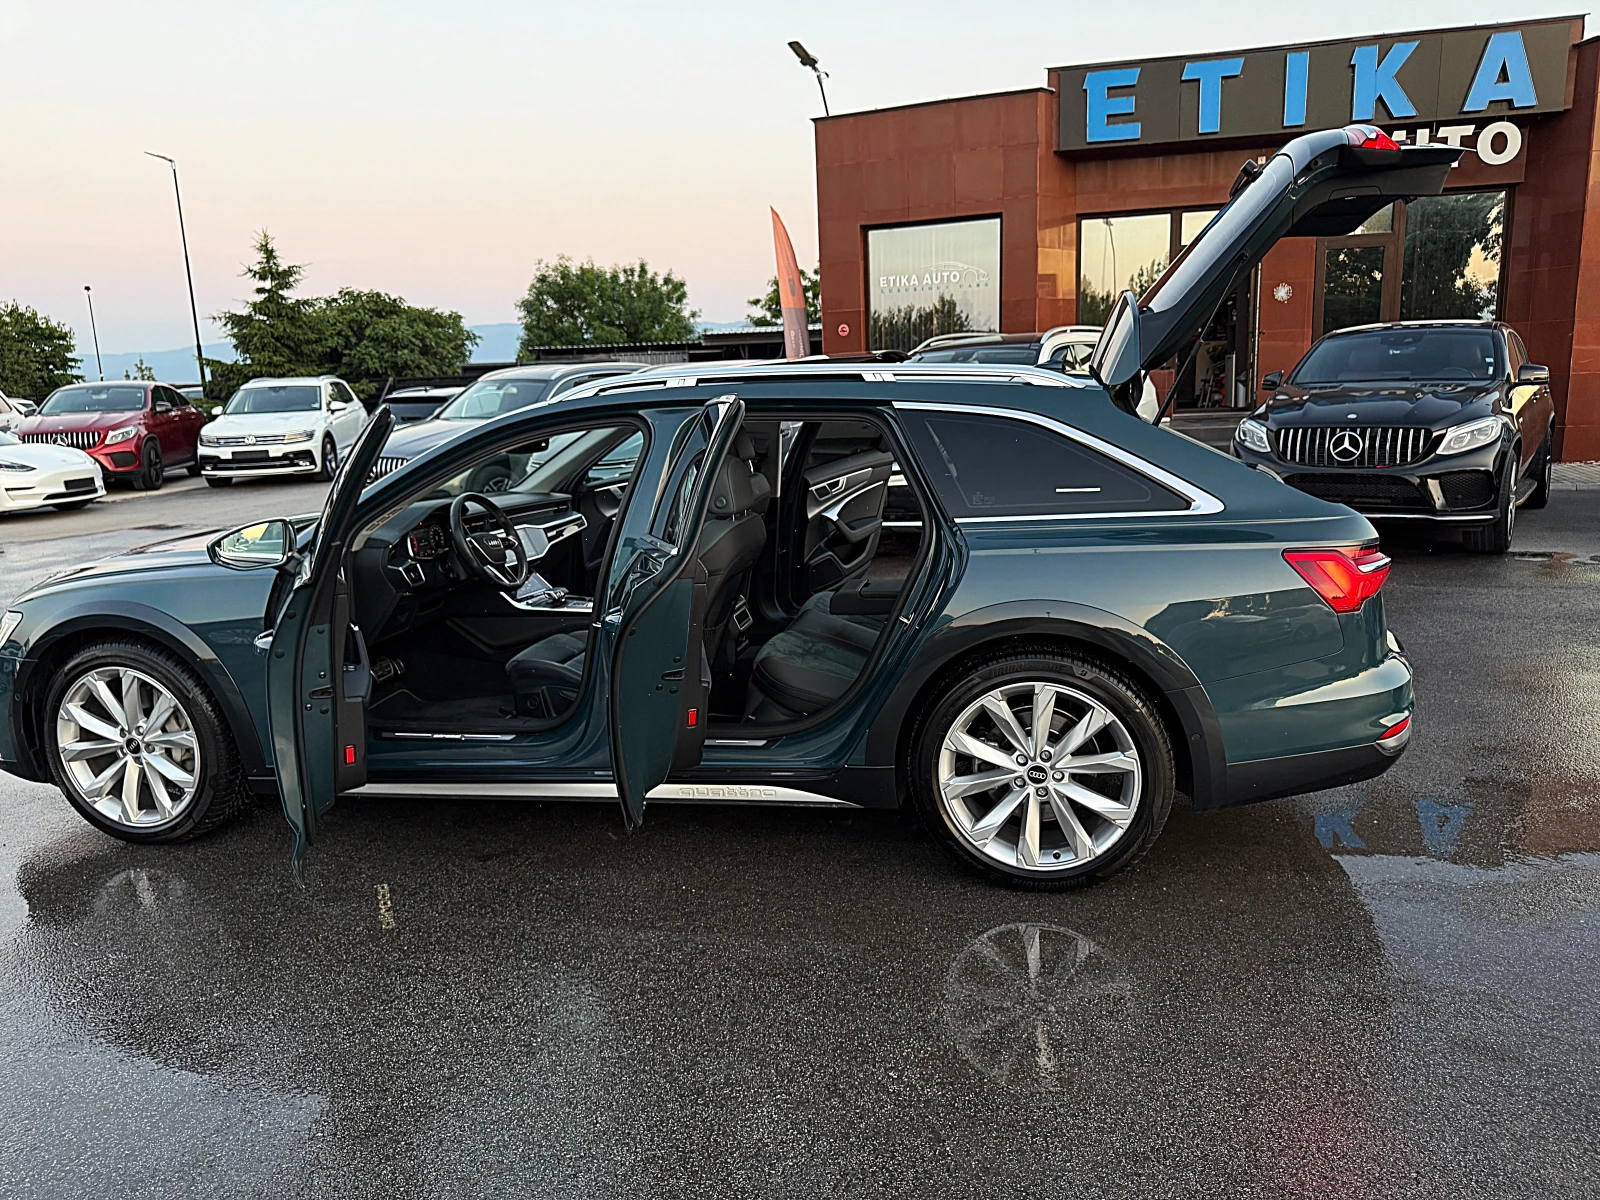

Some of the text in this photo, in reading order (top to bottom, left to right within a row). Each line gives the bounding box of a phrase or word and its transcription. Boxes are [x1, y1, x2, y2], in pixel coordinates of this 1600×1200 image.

[1083, 30, 1538, 143] ETIKA
[880, 271, 960, 288] ETIKA AUTO
[679, 787, 776, 799] quattro
